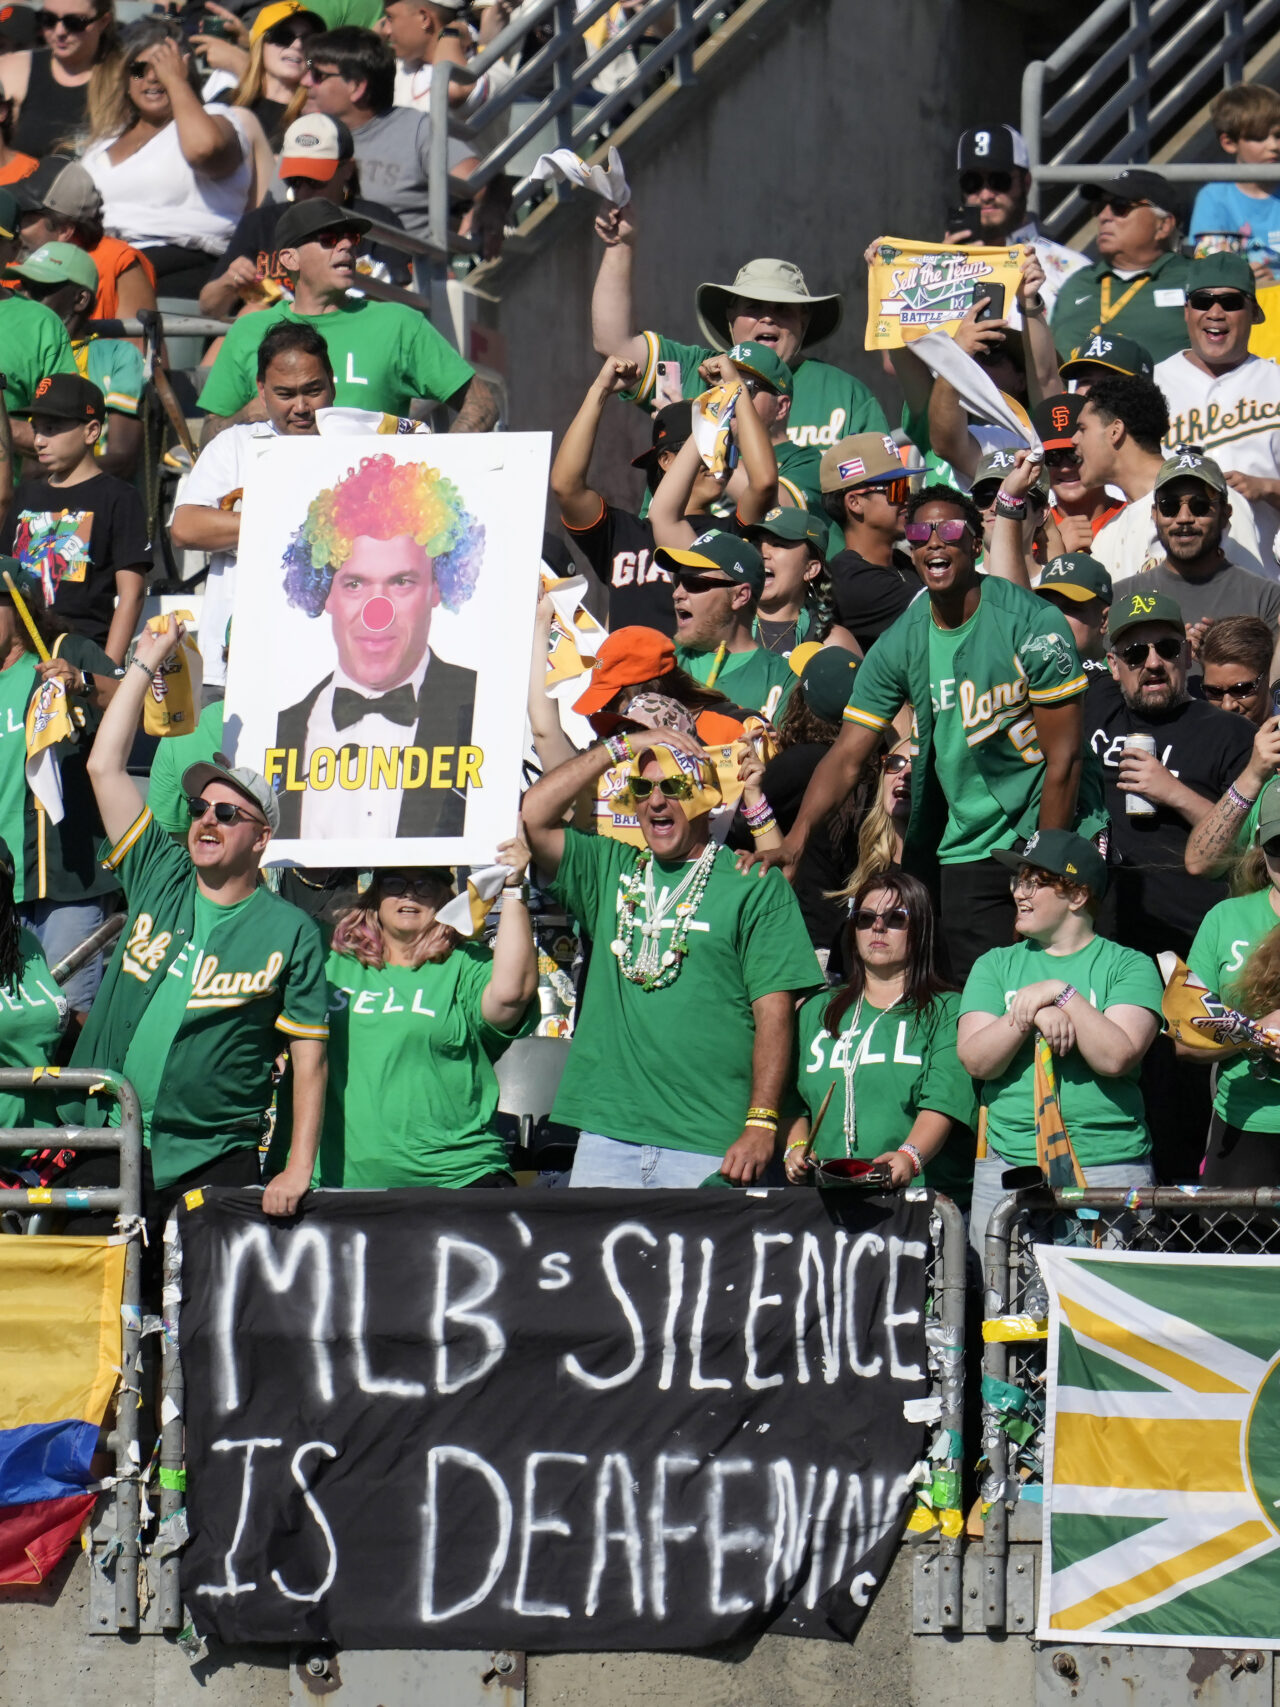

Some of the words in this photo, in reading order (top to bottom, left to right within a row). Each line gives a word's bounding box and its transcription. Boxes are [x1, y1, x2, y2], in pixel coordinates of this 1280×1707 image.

[974, 131, 990, 157] 3
[889, 267, 920, 298] Sell
[920, 264, 942, 287] the
[941, 255, 993, 282] Team
[901, 312, 943, 323] BATTLE
[729, 345, 751, 362] A's
[1085, 335, 1112, 357] A's
[1051, 406, 1070, 432] SF
[988, 450, 1015, 468] A's
[1175, 454, 1201, 470] A's
[1046, 558, 1074, 578] A's
[1128, 594, 1156, 617] A's
[264, 745, 484, 791] FLOUNDER
[673, 749, 693, 773] BAY
[329, 987, 435, 1018] SELL
[806, 1020, 922, 1073] SELL
[216, 1212, 571, 1412] MLB's
[563, 1222, 926, 1391] SILENCE
[196, 1437, 338, 1602] IS
